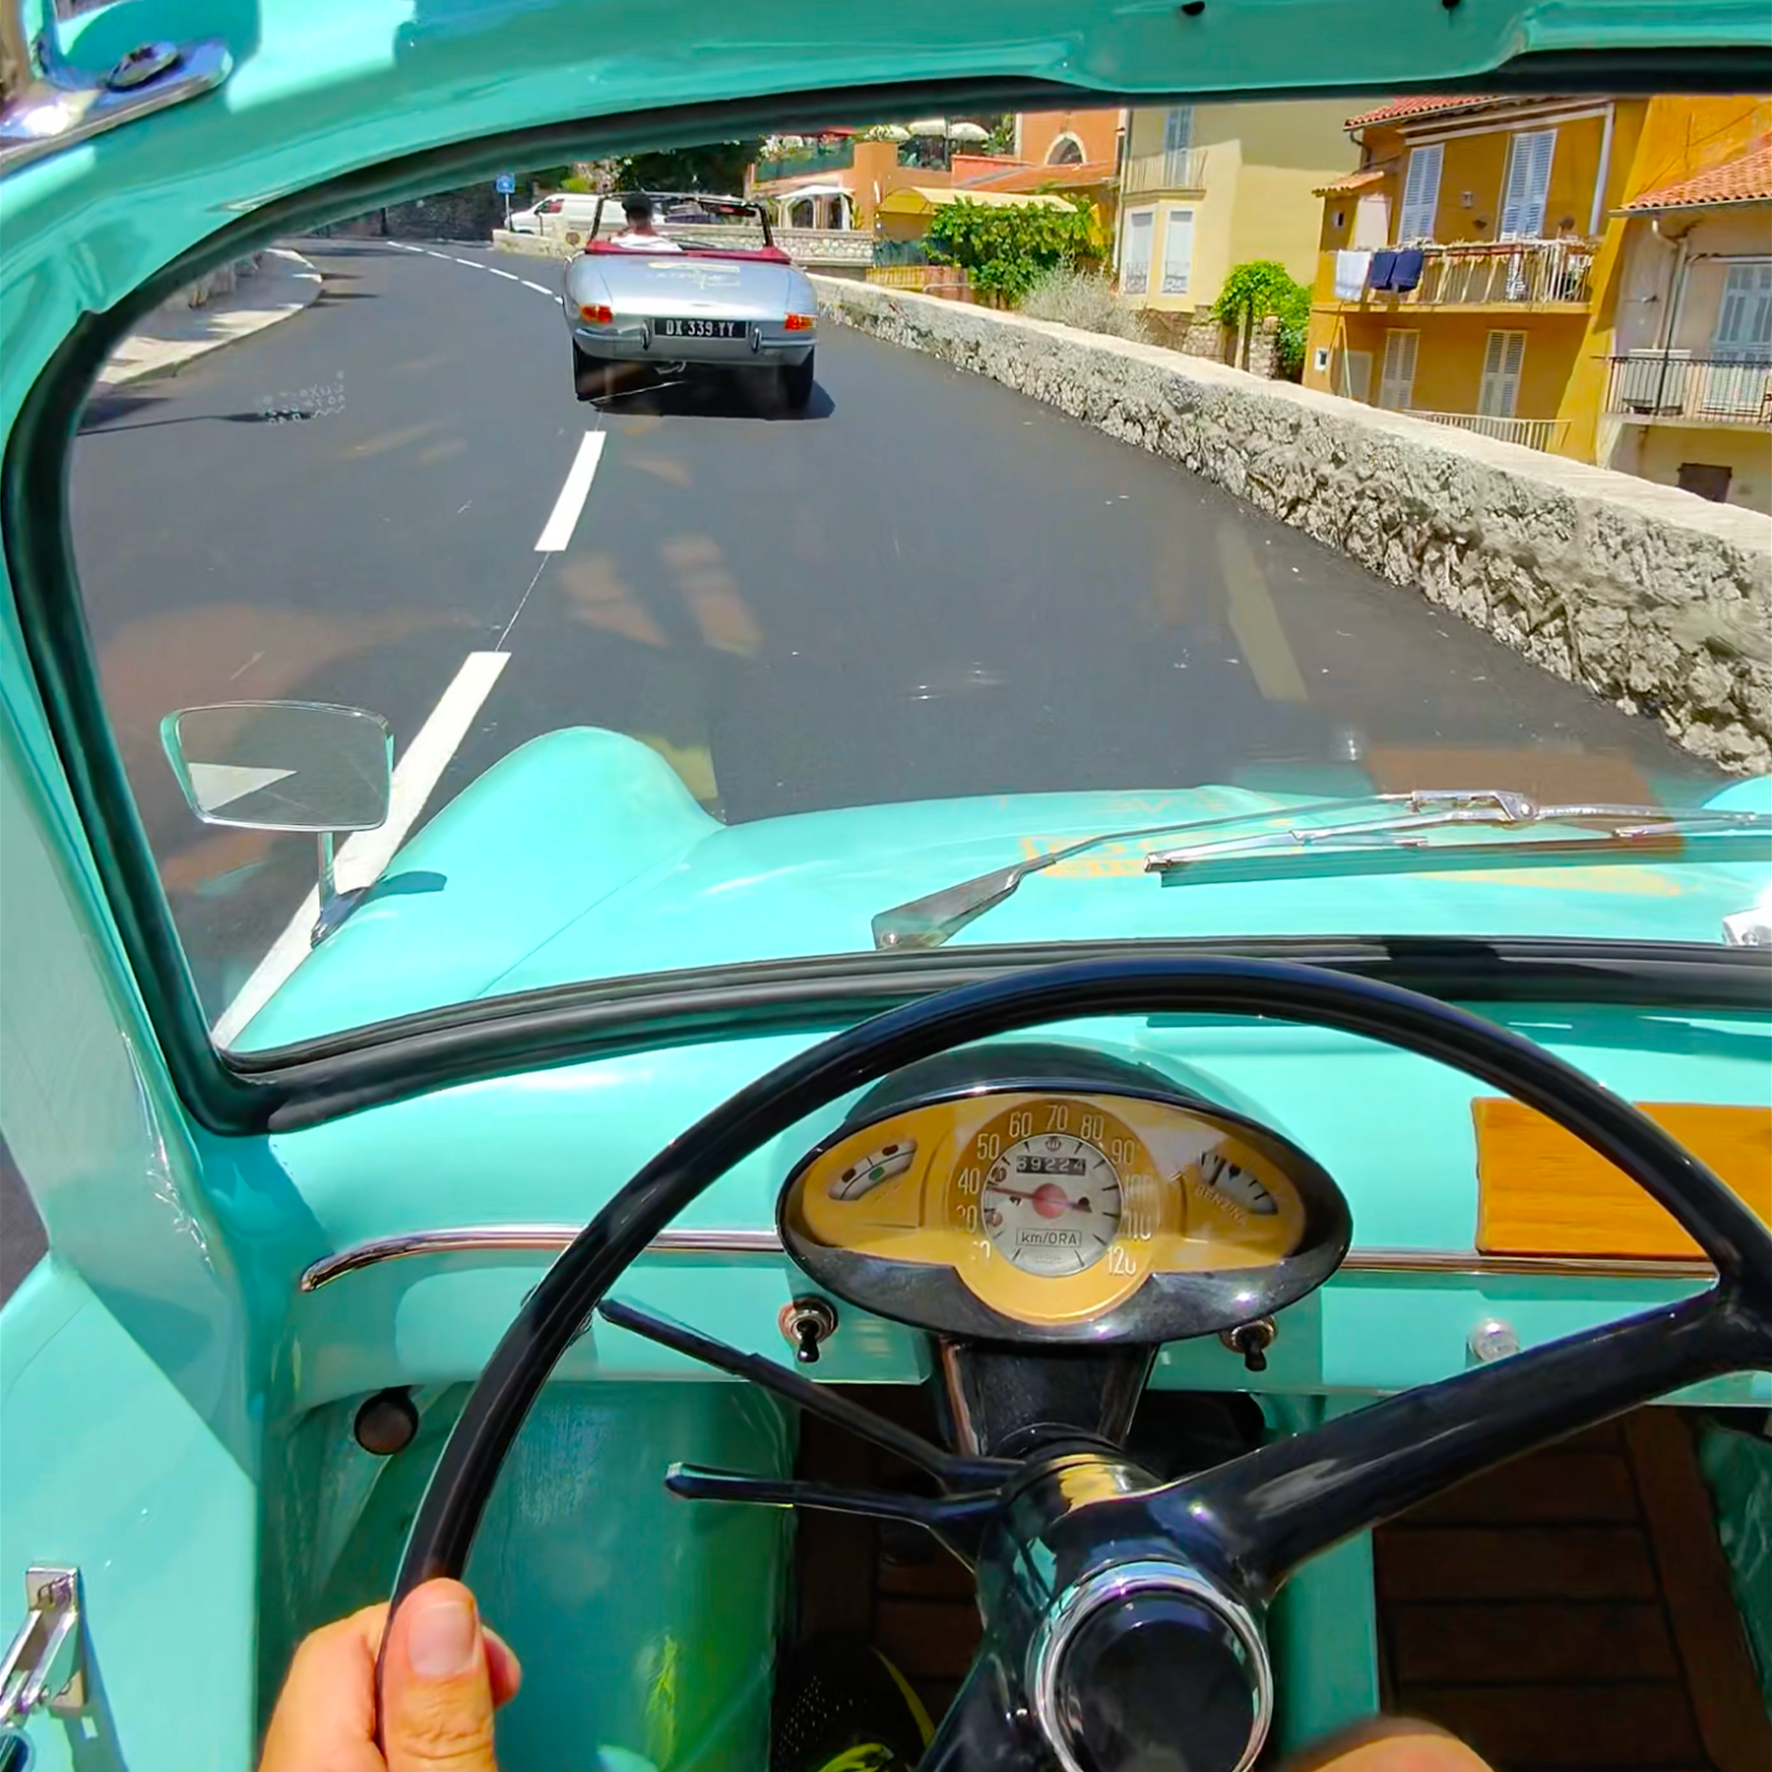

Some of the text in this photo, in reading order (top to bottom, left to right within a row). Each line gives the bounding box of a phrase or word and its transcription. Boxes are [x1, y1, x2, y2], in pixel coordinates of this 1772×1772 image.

[688, 320, 713, 336] 339
[719, 322, 735, 337] YY
[1008, 1111, 1033, 1138] 60
[1046, 1105, 1068, 1131] 70
[1081, 1113, 1104, 1141] 80
[977, 1133, 999, 1160] 50
[1111, 1139, 1135, 1165] 90
[958, 1168, 980, 1195] 40
[1194, 1185, 1248, 1225] BENZINA
[1021, 1231, 1077, 1245] km/ORA
[1107, 1244, 1137, 1275] 120
